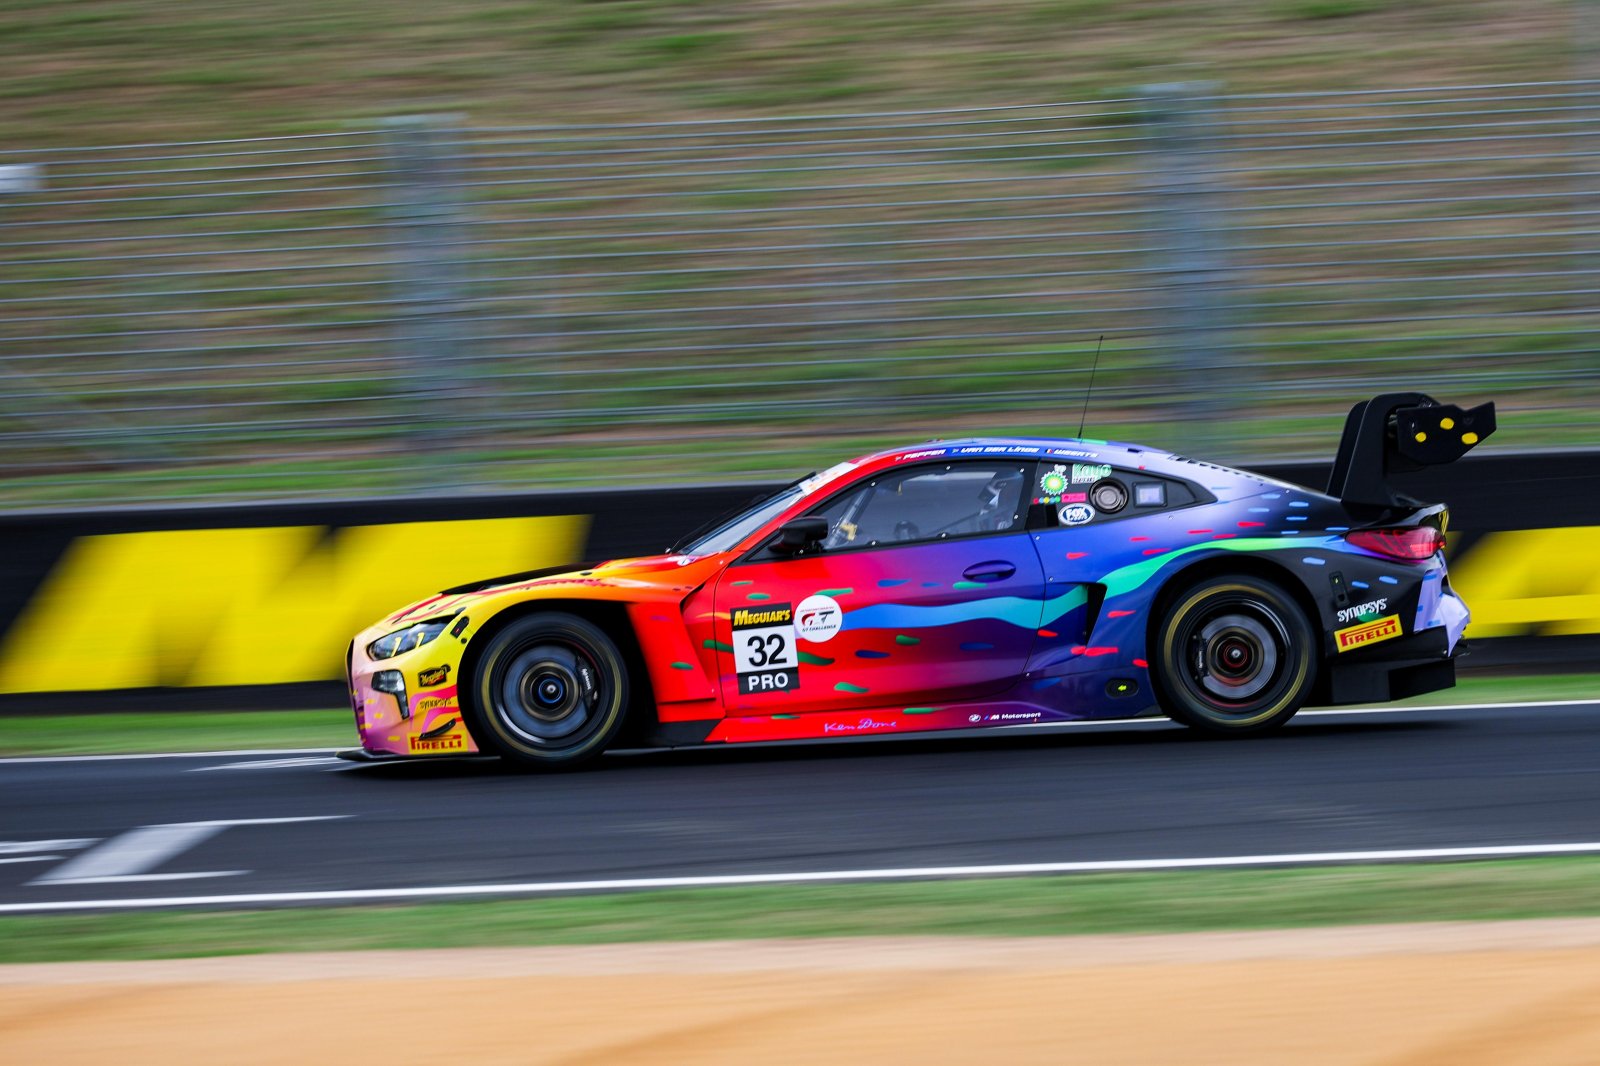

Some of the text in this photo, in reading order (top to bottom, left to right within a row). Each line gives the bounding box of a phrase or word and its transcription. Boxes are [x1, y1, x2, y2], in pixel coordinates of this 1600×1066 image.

[1065, 506, 1089, 520] FOX
[733, 609, 791, 627] MEGUIAR'S
[1339, 619, 1397, 648] PIRELLI
[747, 633, 788, 668] 32
[747, 672, 789, 692] PRO
[1001, 712, 1041, 720] Motorsport
[824, 722, 855, 733] Ken
[410, 734, 462, 751] PIRELLI
